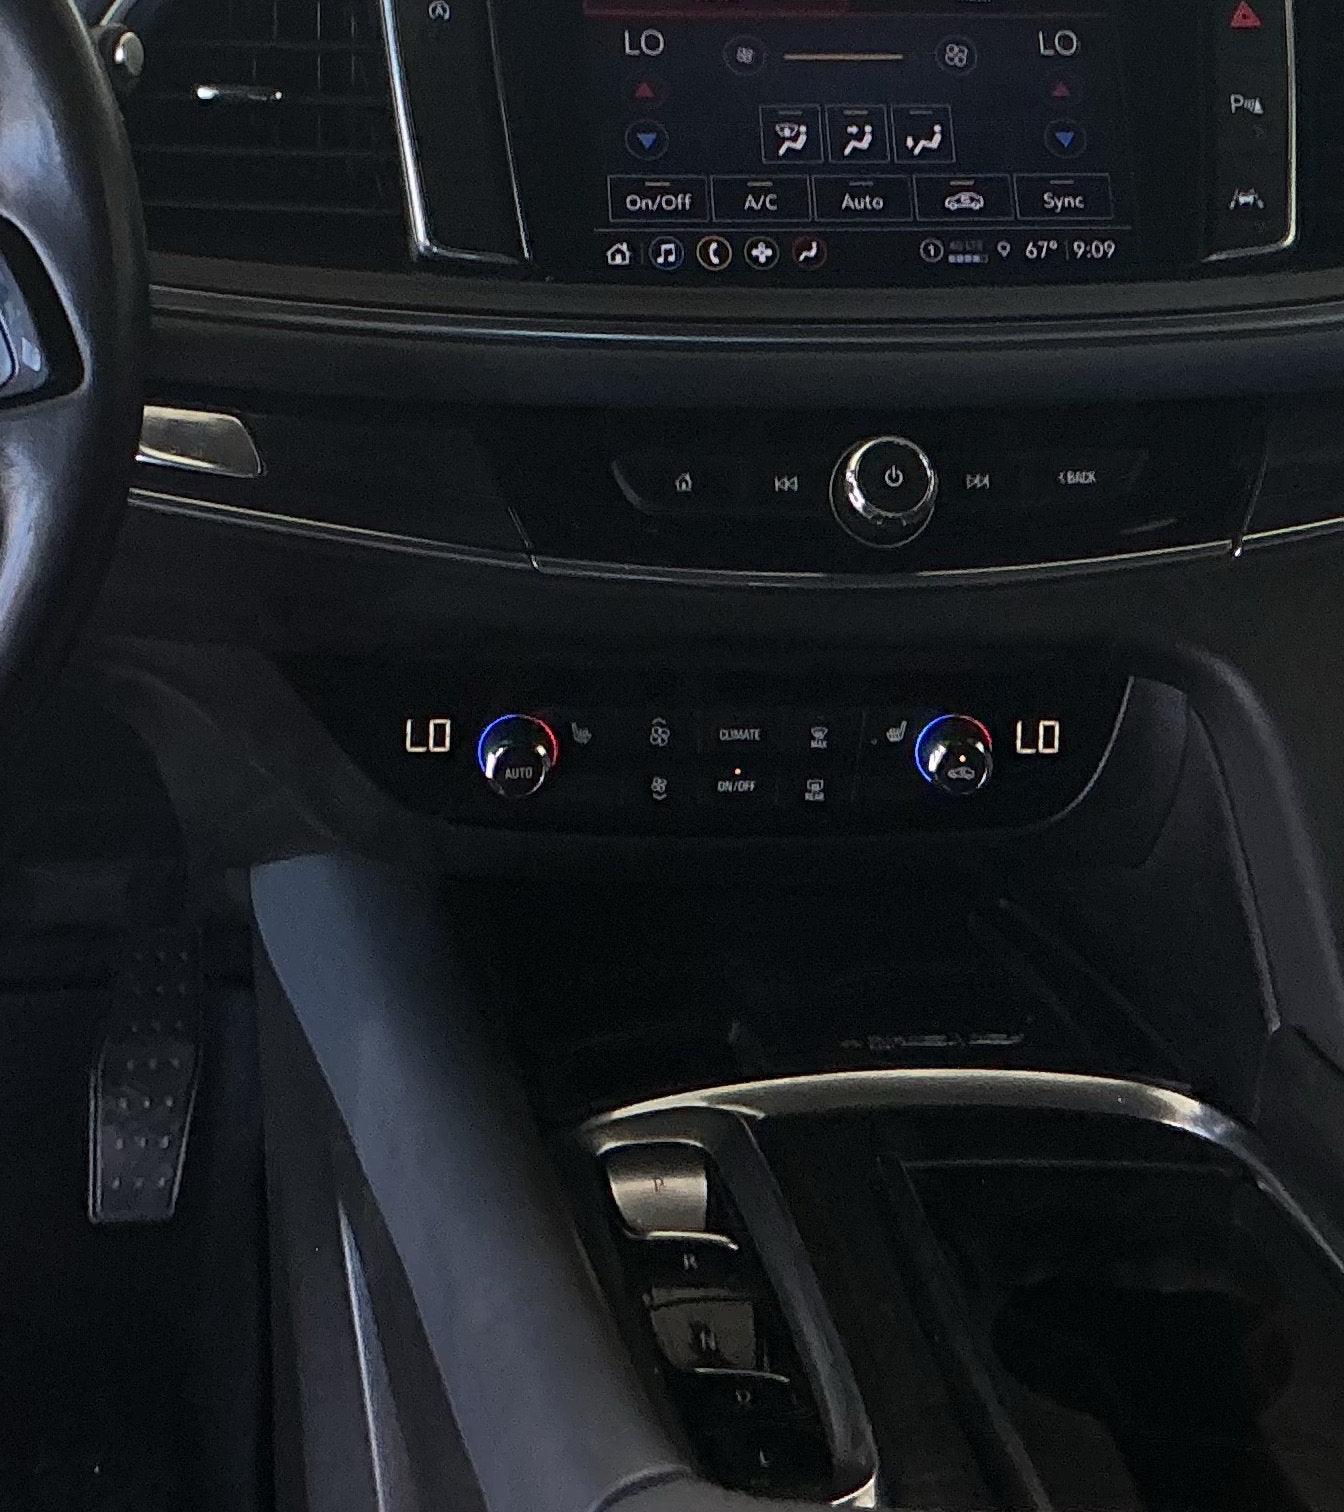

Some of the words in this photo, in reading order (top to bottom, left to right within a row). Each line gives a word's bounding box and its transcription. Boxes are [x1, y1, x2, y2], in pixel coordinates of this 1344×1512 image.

[624, 29, 665, 56] LO
[1038, 29, 1078, 56] LO
[625, 193, 692, 212] On/Off
[744, 193, 778, 211] A/C
[841, 193, 884, 211] Auto
[1043, 192, 1086, 213] Sync
[1026, 241, 1059, 259] 67°
[1074, 241, 1116, 259] 9:09
[1067, 470, 1096, 484] BACK
[406, 719, 451, 752] LO
[719, 728, 761, 741] CLIMATE
[1016, 720, 1060, 754] LO
[810, 740, 827, 749] MAX
[505, 766, 533, 779] AUTO
[717, 780, 755, 792] ON/OFF
